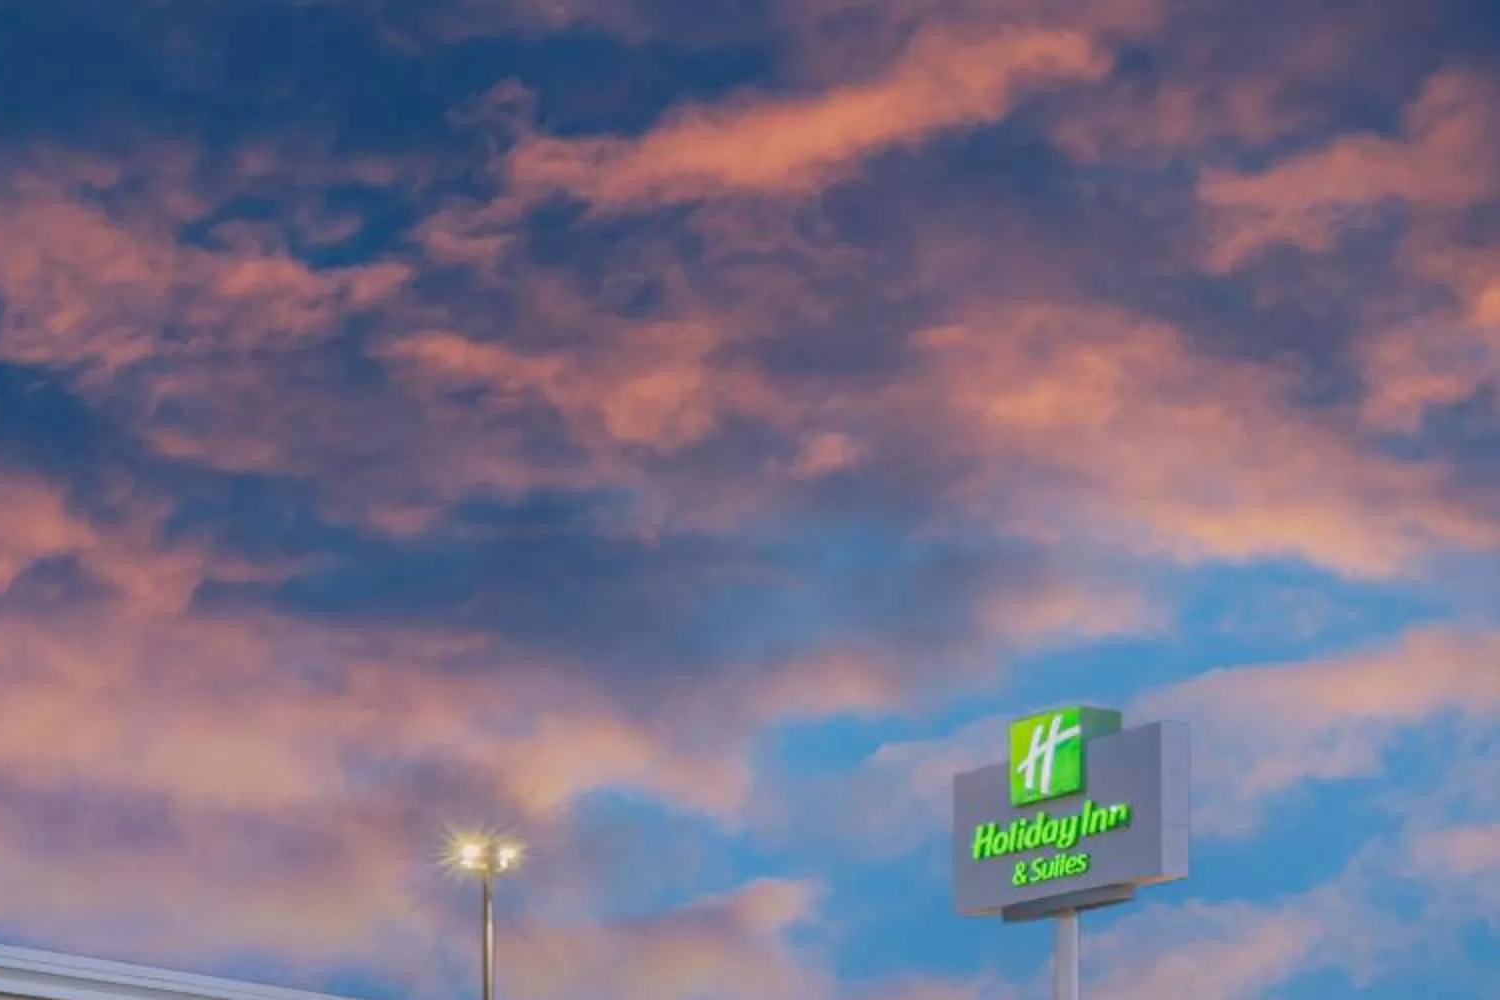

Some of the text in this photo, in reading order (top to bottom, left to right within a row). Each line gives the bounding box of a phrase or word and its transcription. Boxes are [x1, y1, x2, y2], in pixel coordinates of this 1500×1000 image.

[973, 800, 1129, 860] Holiday Inn
[1012, 853, 1088, 885] & Suites
